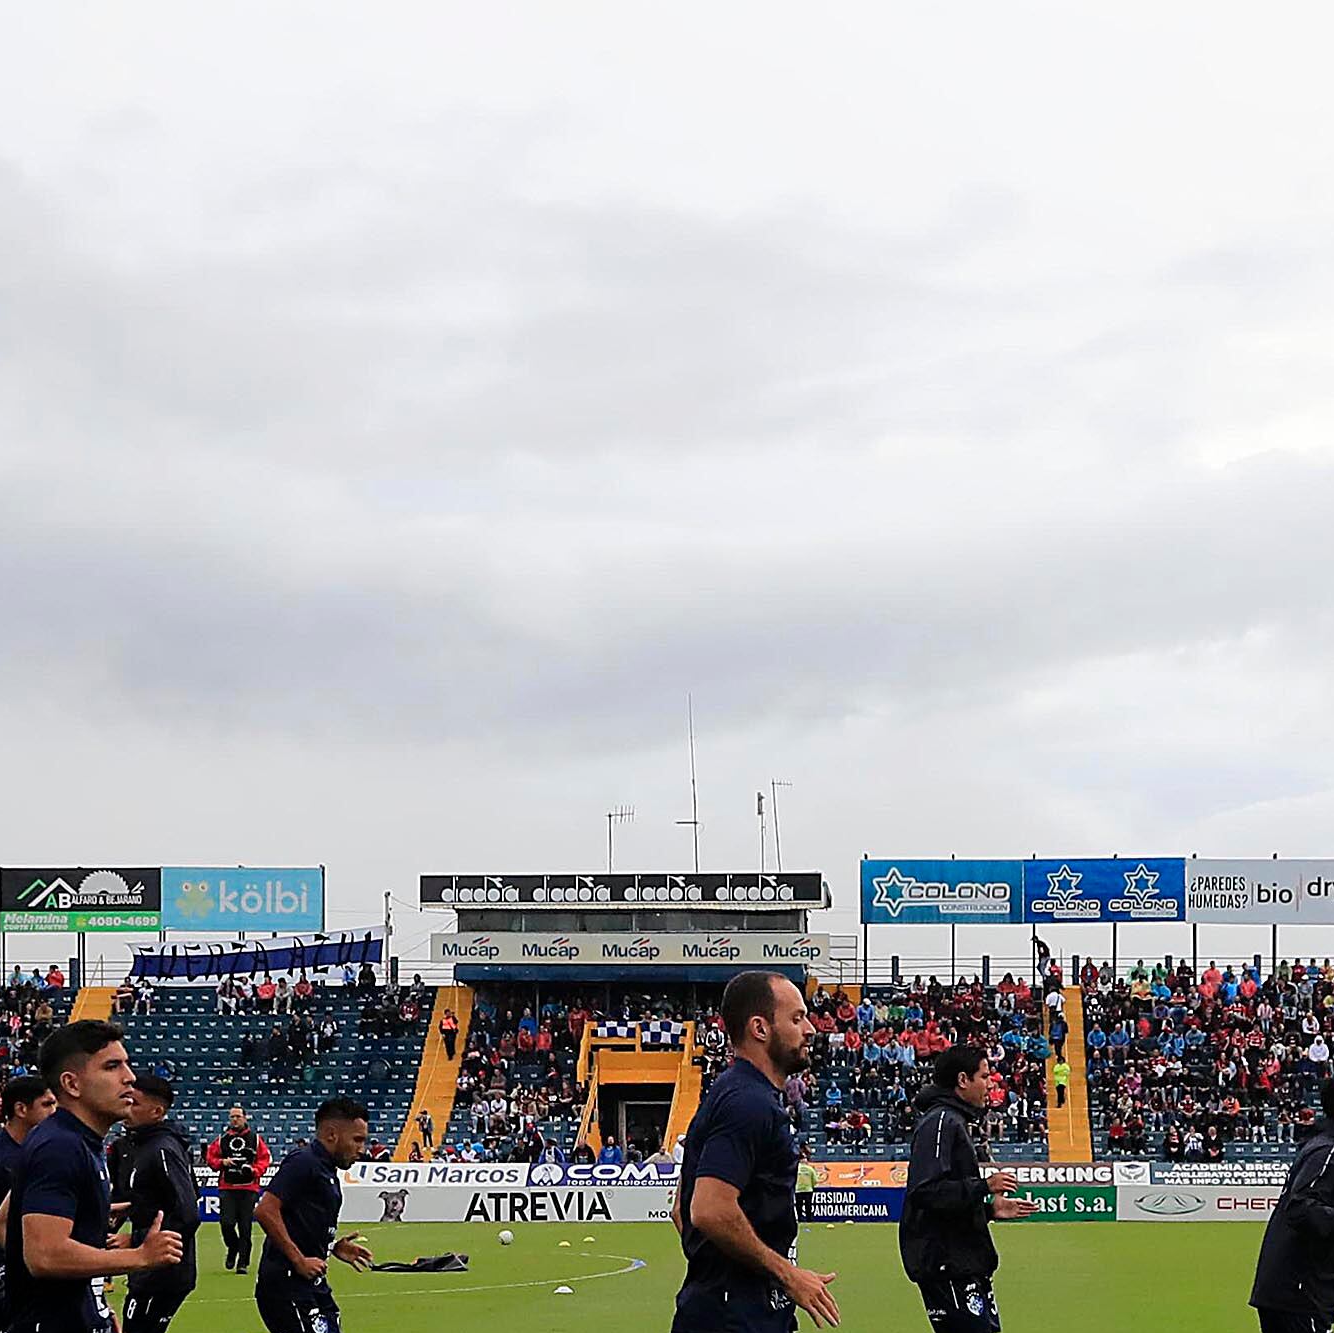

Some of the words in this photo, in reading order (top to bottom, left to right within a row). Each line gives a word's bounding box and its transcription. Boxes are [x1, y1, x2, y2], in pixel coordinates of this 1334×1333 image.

[441, 874, 520, 902] diadora
[532, 874, 611, 902] diadora
[623, 874, 703, 902] diadora
[715, 874, 794, 902] diadora
[908, 885, 1009, 900] COLONO
[1190, 876, 1246, 892] ¿PAREDES
[71, 894, 97, 905] ALFARO
[218, 879, 309, 913] kölbi
[1256, 883, 1294, 904] bio
[1032, 899, 1100, 912] COLONO
[1108, 899, 1177, 911] COLONO
[441, 942, 500, 961] Mucap
[521, 942, 580, 961] Mucap
[601, 942, 660, 961] Mucap
[682, 942, 741, 961] Mucap
[762, 942, 821, 961] Mucap
[372, 1165, 418, 1183] San
[427, 1165, 519, 1184] Marcos
[1172, 1163, 1242, 1171] ACADEMIA
[1245, 1163, 1292, 1171] BRECA
[464, 1191, 613, 1222] ATREVIA
[1074, 1195, 1114, 1213] s.a.
